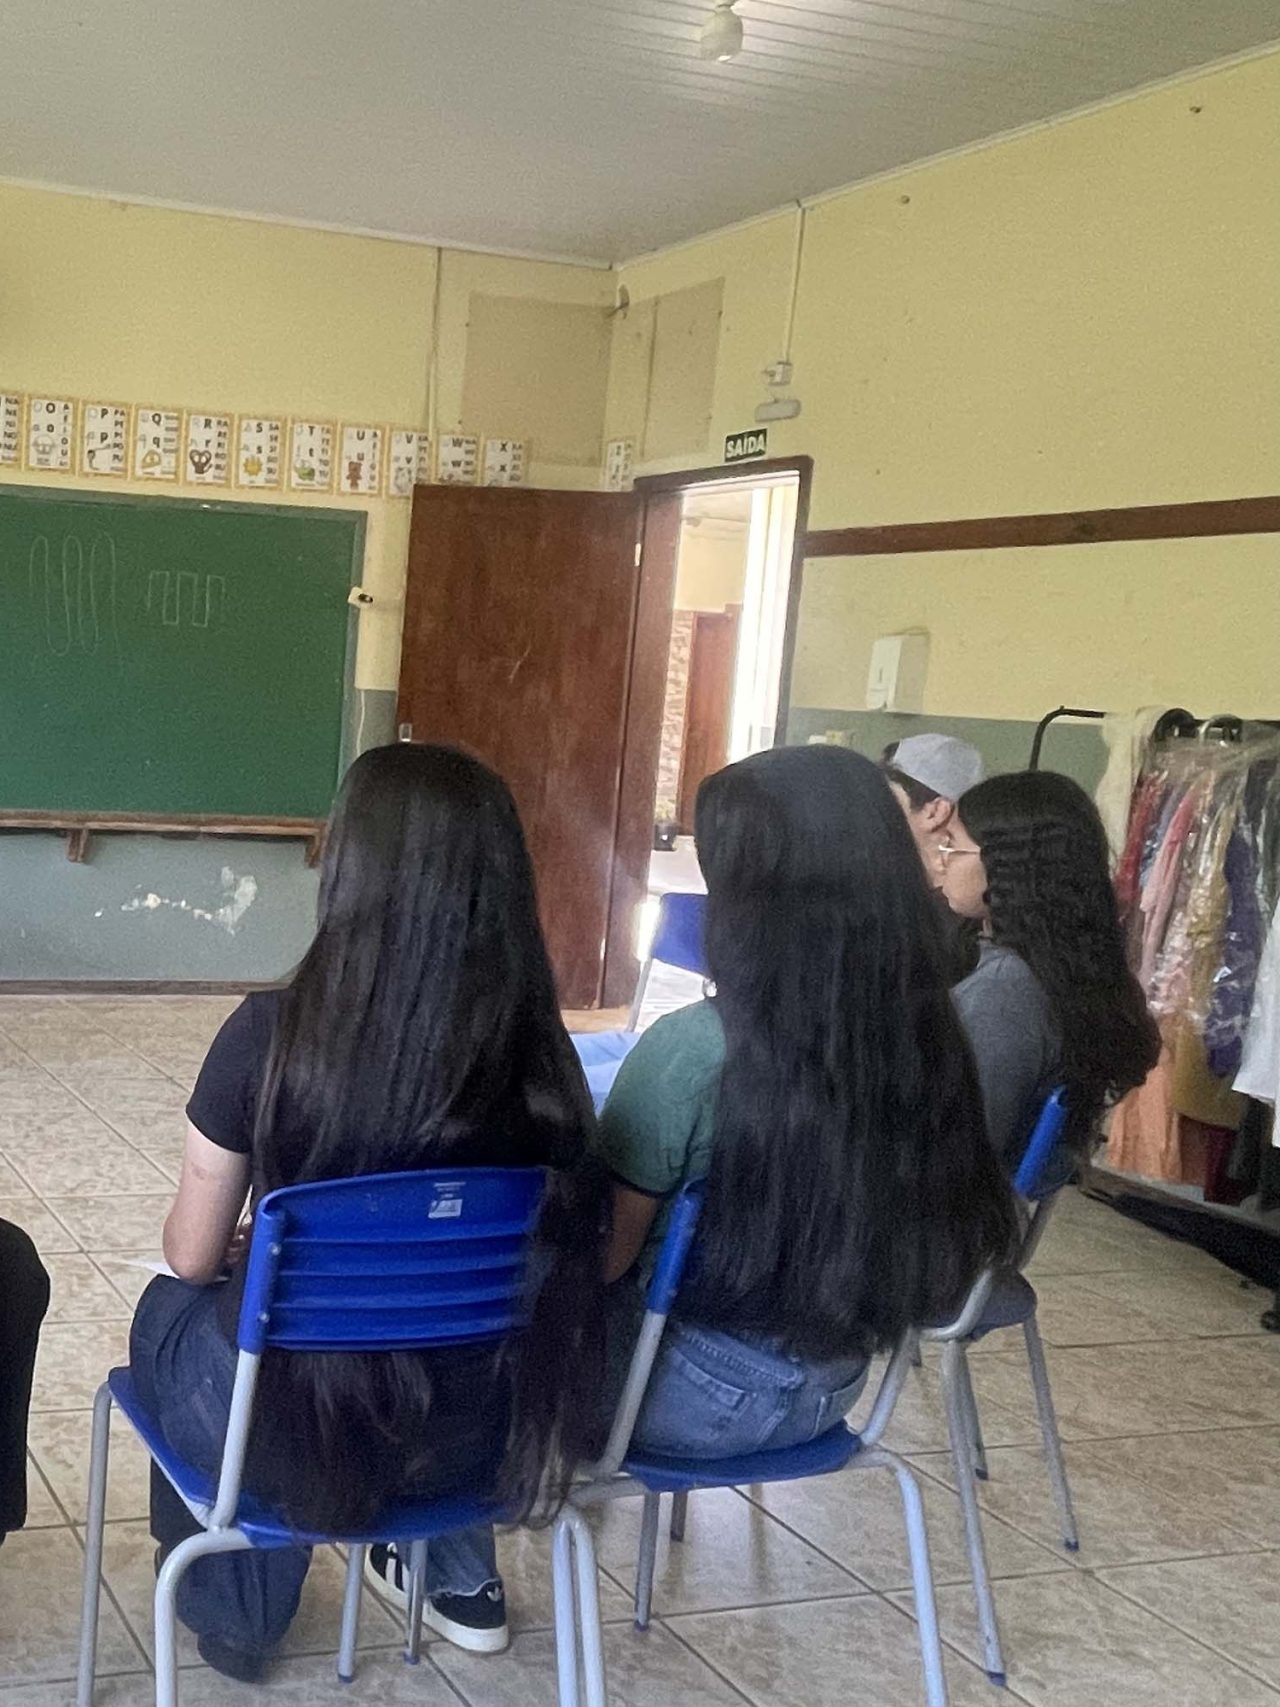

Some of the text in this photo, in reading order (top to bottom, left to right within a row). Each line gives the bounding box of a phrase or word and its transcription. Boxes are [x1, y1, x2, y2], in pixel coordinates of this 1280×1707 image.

[45, 402, 56, 414] O
[101, 408, 109, 419] P
[151, 413, 161, 426] Q
[46, 424, 54, 433] o
[256, 422, 263, 433] S
[308, 426, 315, 436] T
[100, 432, 108, 443] p
[357, 430, 365, 441] U
[726, 434, 765, 458] SAÍDA
